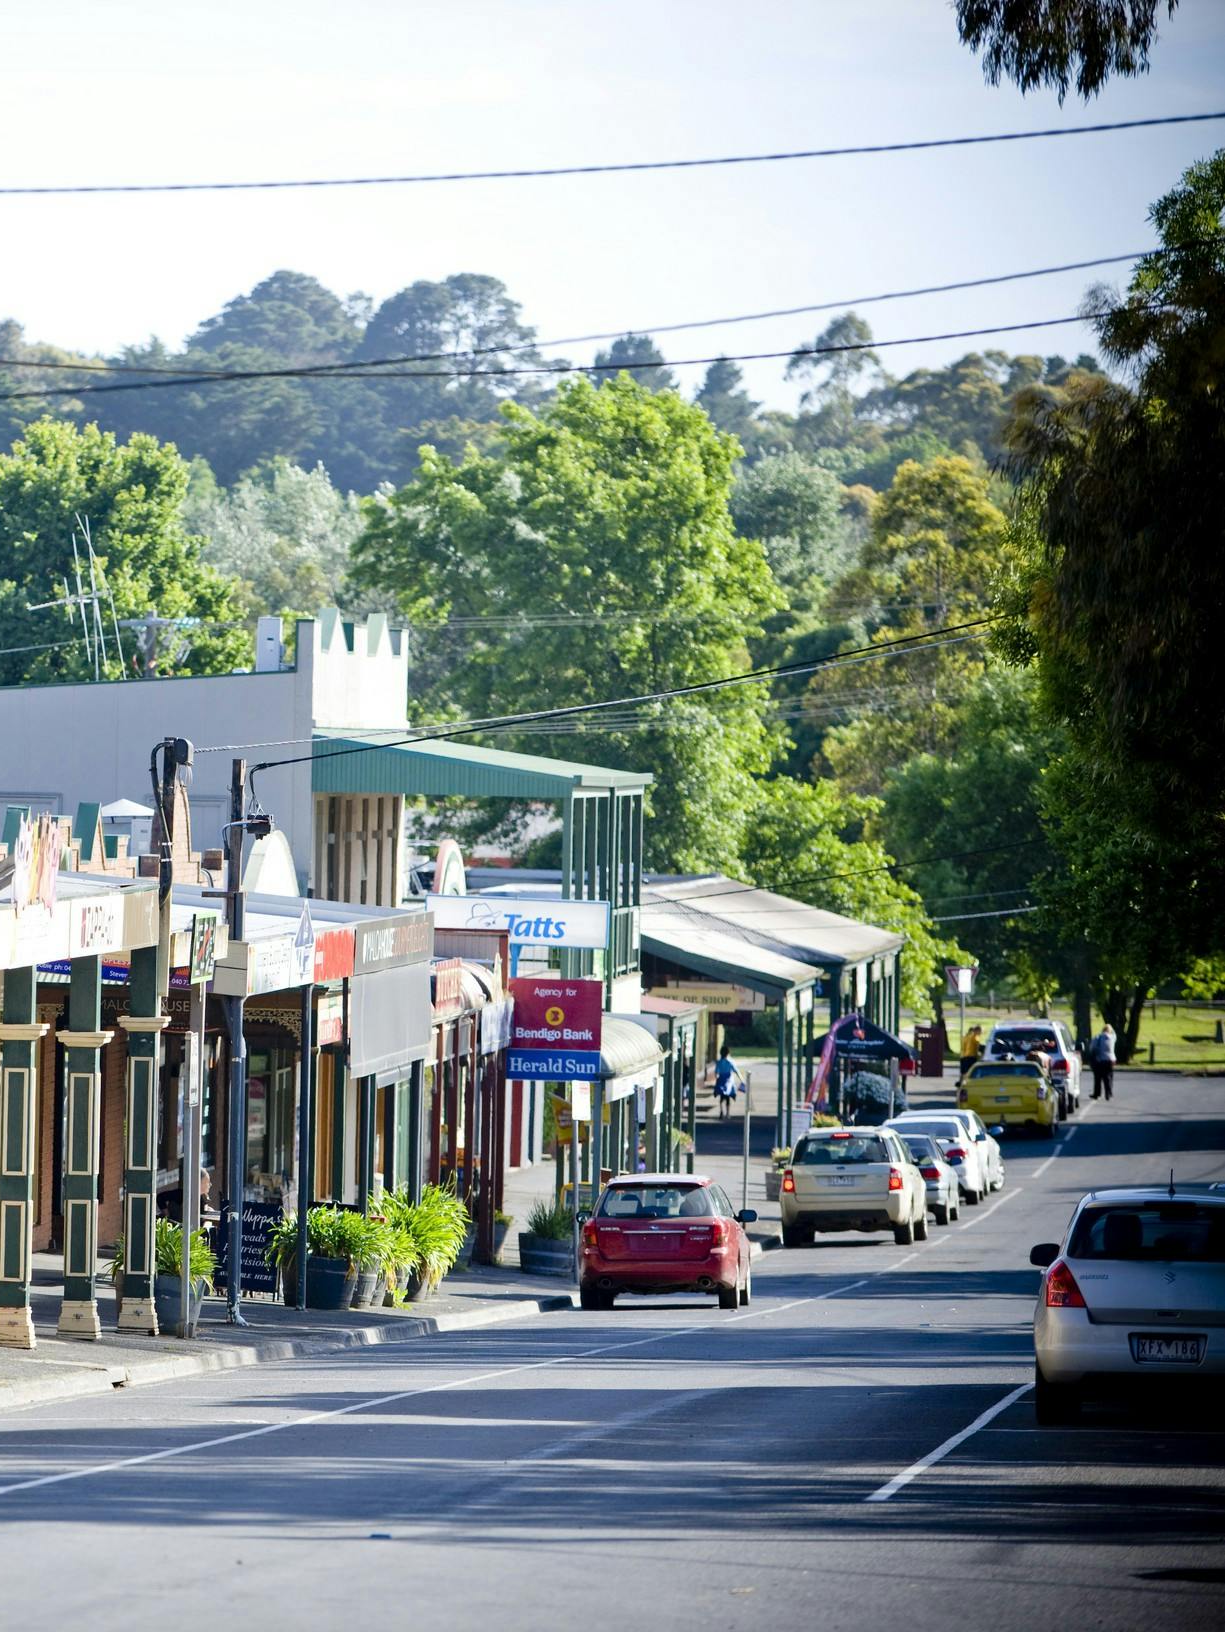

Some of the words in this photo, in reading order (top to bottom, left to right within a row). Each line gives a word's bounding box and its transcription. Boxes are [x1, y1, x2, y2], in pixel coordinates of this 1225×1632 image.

[504, 913, 566, 939] Tatts
[534, 987, 562, 998] Agency
[566, 987, 577, 996] for
[701, 995, 731, 1005] SHOP
[515, 1027, 561, 1041] Bendigo
[562, 1028, 593, 1041] Bank
[509, 1057, 563, 1073] Herald
[564, 1058, 596, 1074] Sun
[1139, 1339, 1164, 1355] XFX
